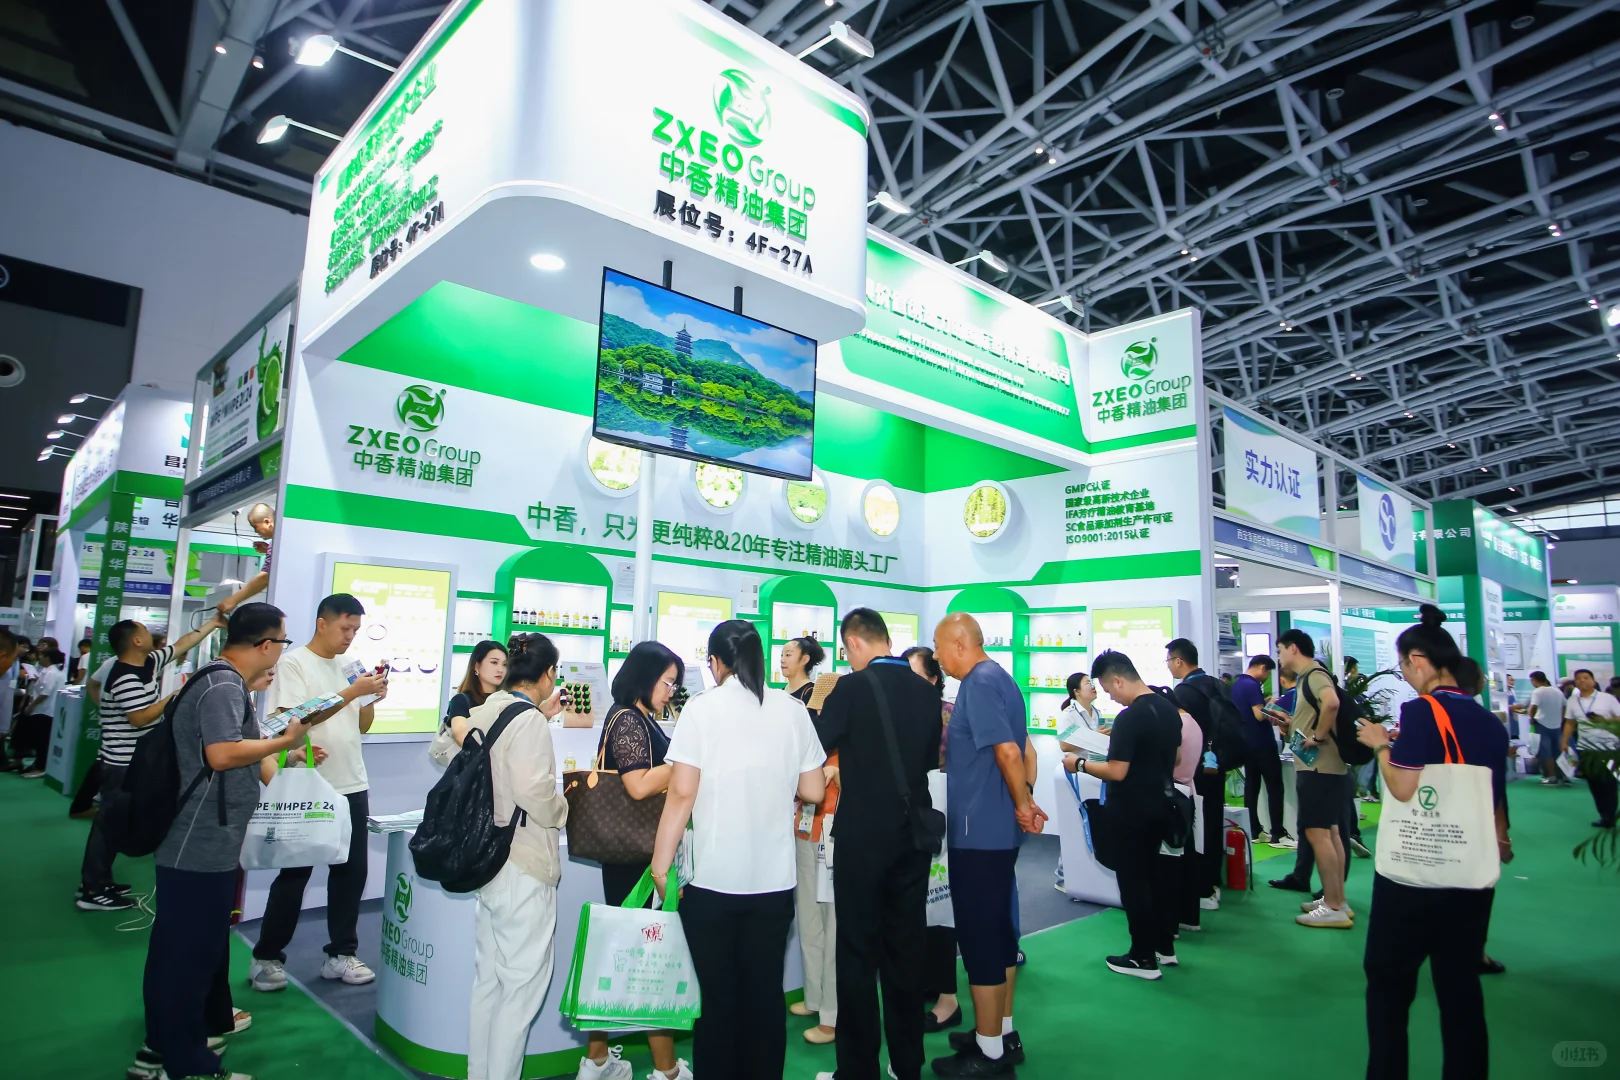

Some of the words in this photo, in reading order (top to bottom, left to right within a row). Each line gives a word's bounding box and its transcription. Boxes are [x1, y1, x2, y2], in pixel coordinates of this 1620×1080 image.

[652, 106, 744, 173] ZXEO
[748, 155, 816, 213] Group
[660, 149, 808, 242] 中香精油集团
[1092, 384, 1143, 407] ZXEO
[1144, 375, 1192, 395] Group
[1097, 392, 1187, 424] 中香精油集团
[347, 424, 421, 454] ZXEO
[424, 438, 481, 468] Group
[353, 449, 474, 487] 中香精油集团
[1065, 480, 1111, 494] GMPC认证
[1245, 449, 1301, 499] 实力认证
[1065, 528, 1150, 544] ISO9001:2015认证
[381, 912, 401, 945] ZXEO
[401, 929, 434, 963] Group
